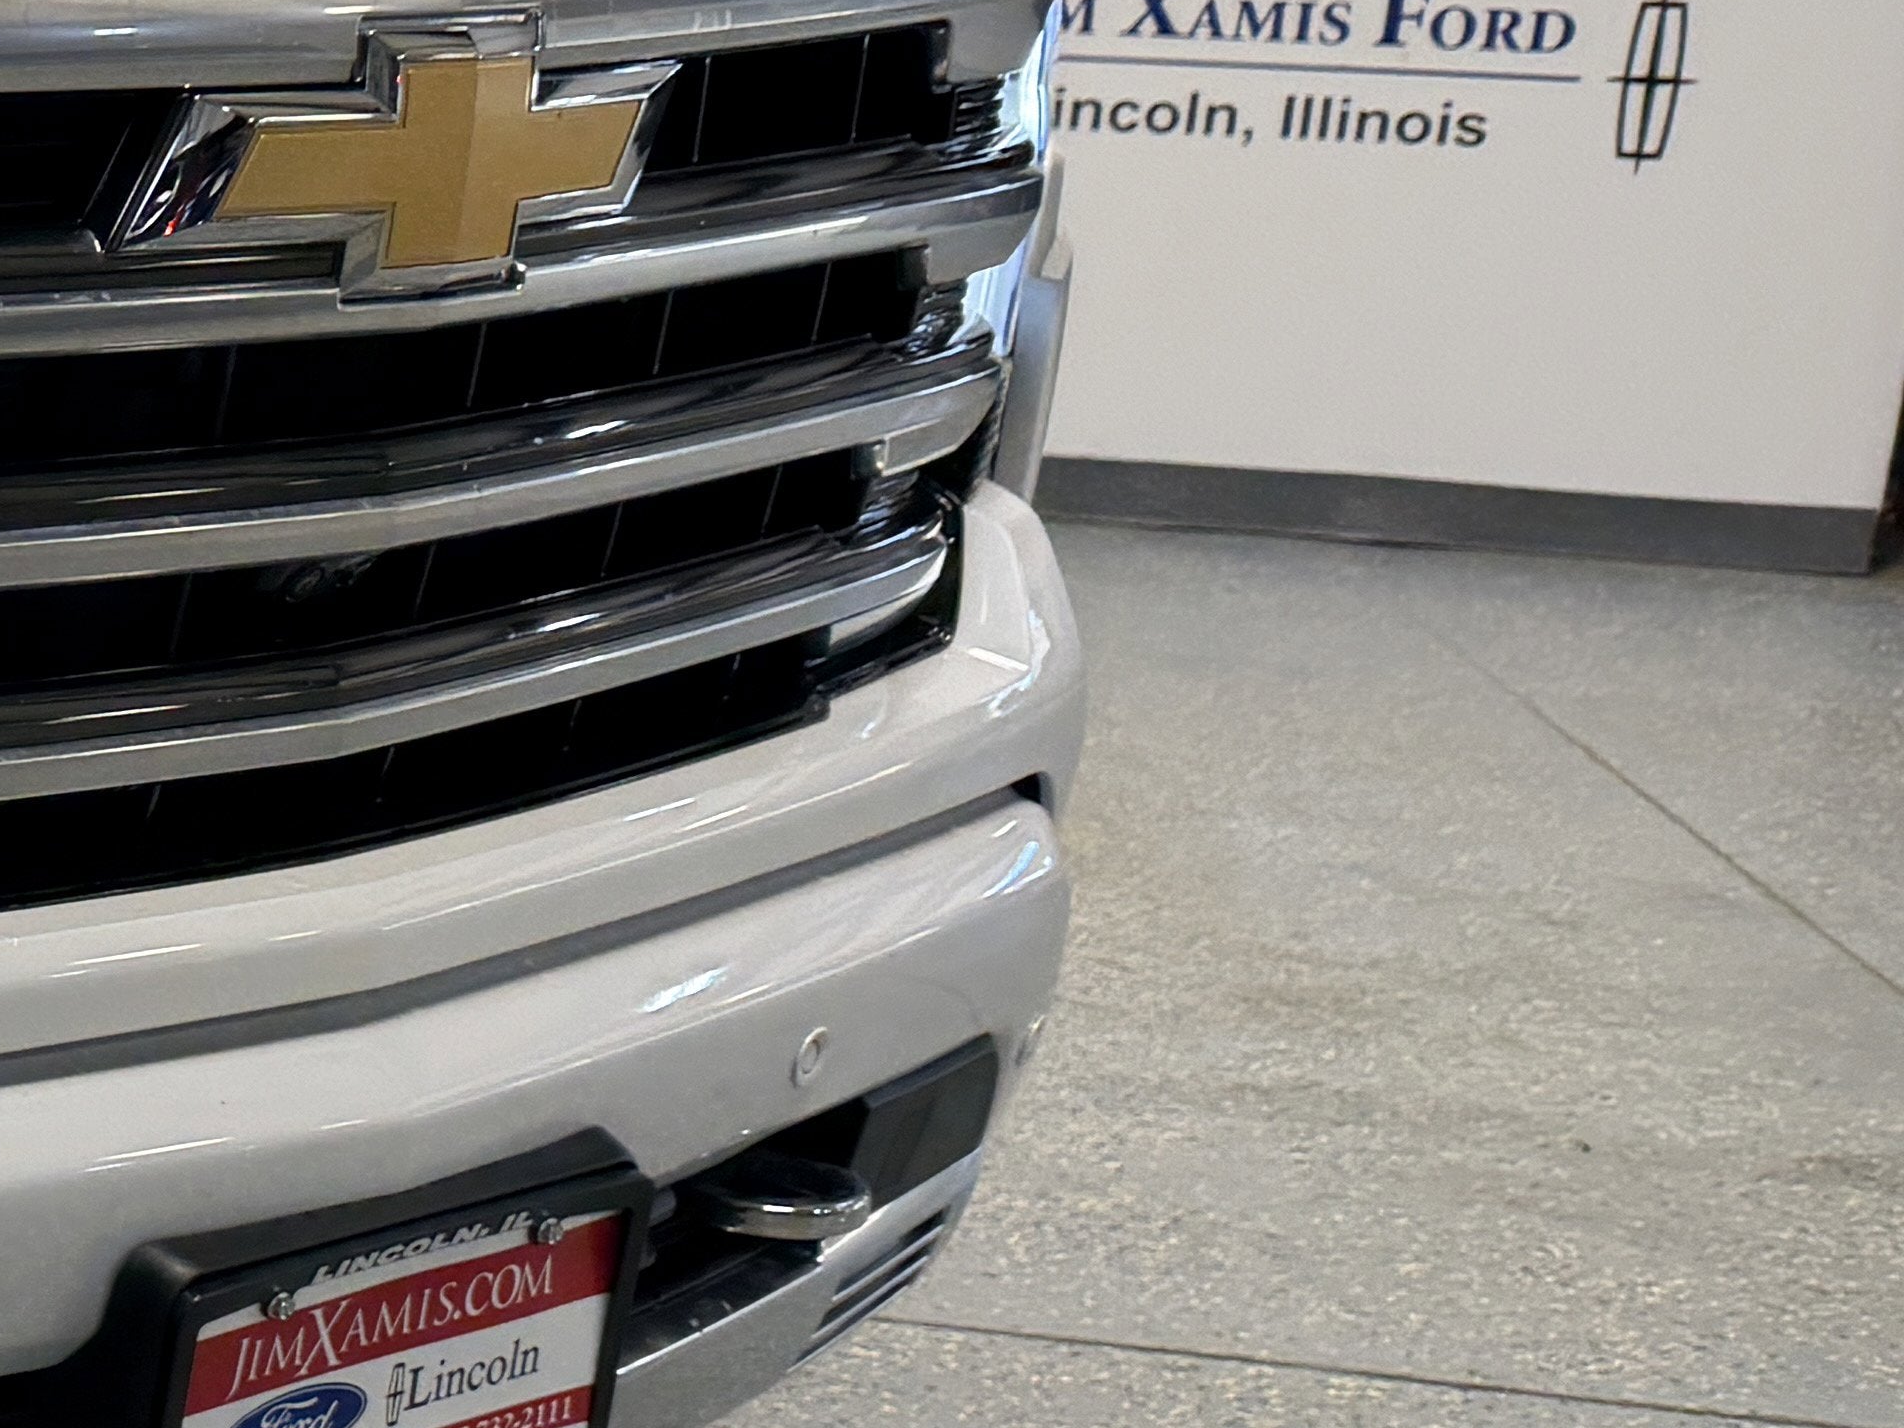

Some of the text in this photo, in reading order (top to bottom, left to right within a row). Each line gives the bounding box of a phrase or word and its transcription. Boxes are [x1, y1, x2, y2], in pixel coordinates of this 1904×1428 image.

[1051, 85, 1489, 148] incoln, Illinois
[227, 1253, 554, 1401] JIMXAMIS.COM
[402, 1338, 540, 1411] Lincoln
